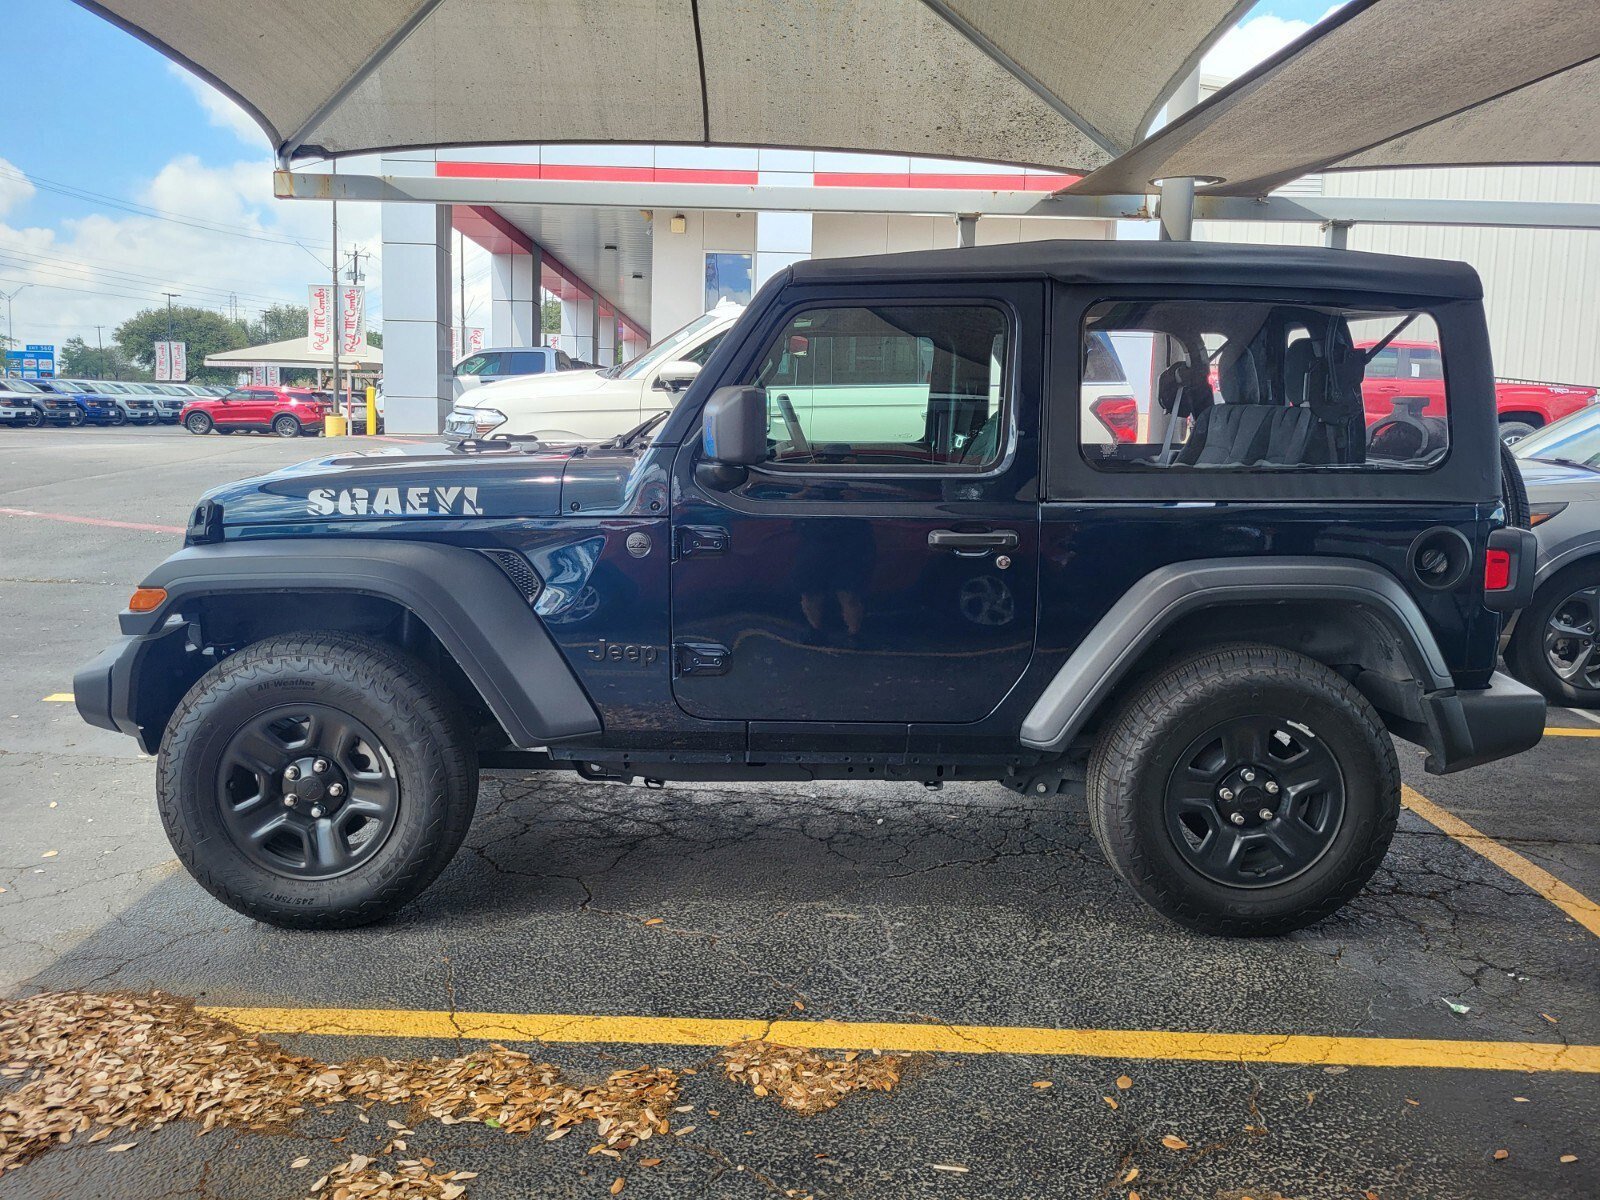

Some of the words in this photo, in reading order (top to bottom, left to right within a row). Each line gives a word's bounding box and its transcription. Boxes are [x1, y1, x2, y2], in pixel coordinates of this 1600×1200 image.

[314, 288, 325, 330] McCombs
[344, 289, 356, 332] McCombs
[313, 332, 329, 351] Red
[344, 334, 361, 352] Red
[306, 486, 483, 515] SGAEYL
[587, 638, 658, 667] Jeep
[257, 678, 316, 692] All-Weather
[262, 891, 315, 906] 245/75R17
